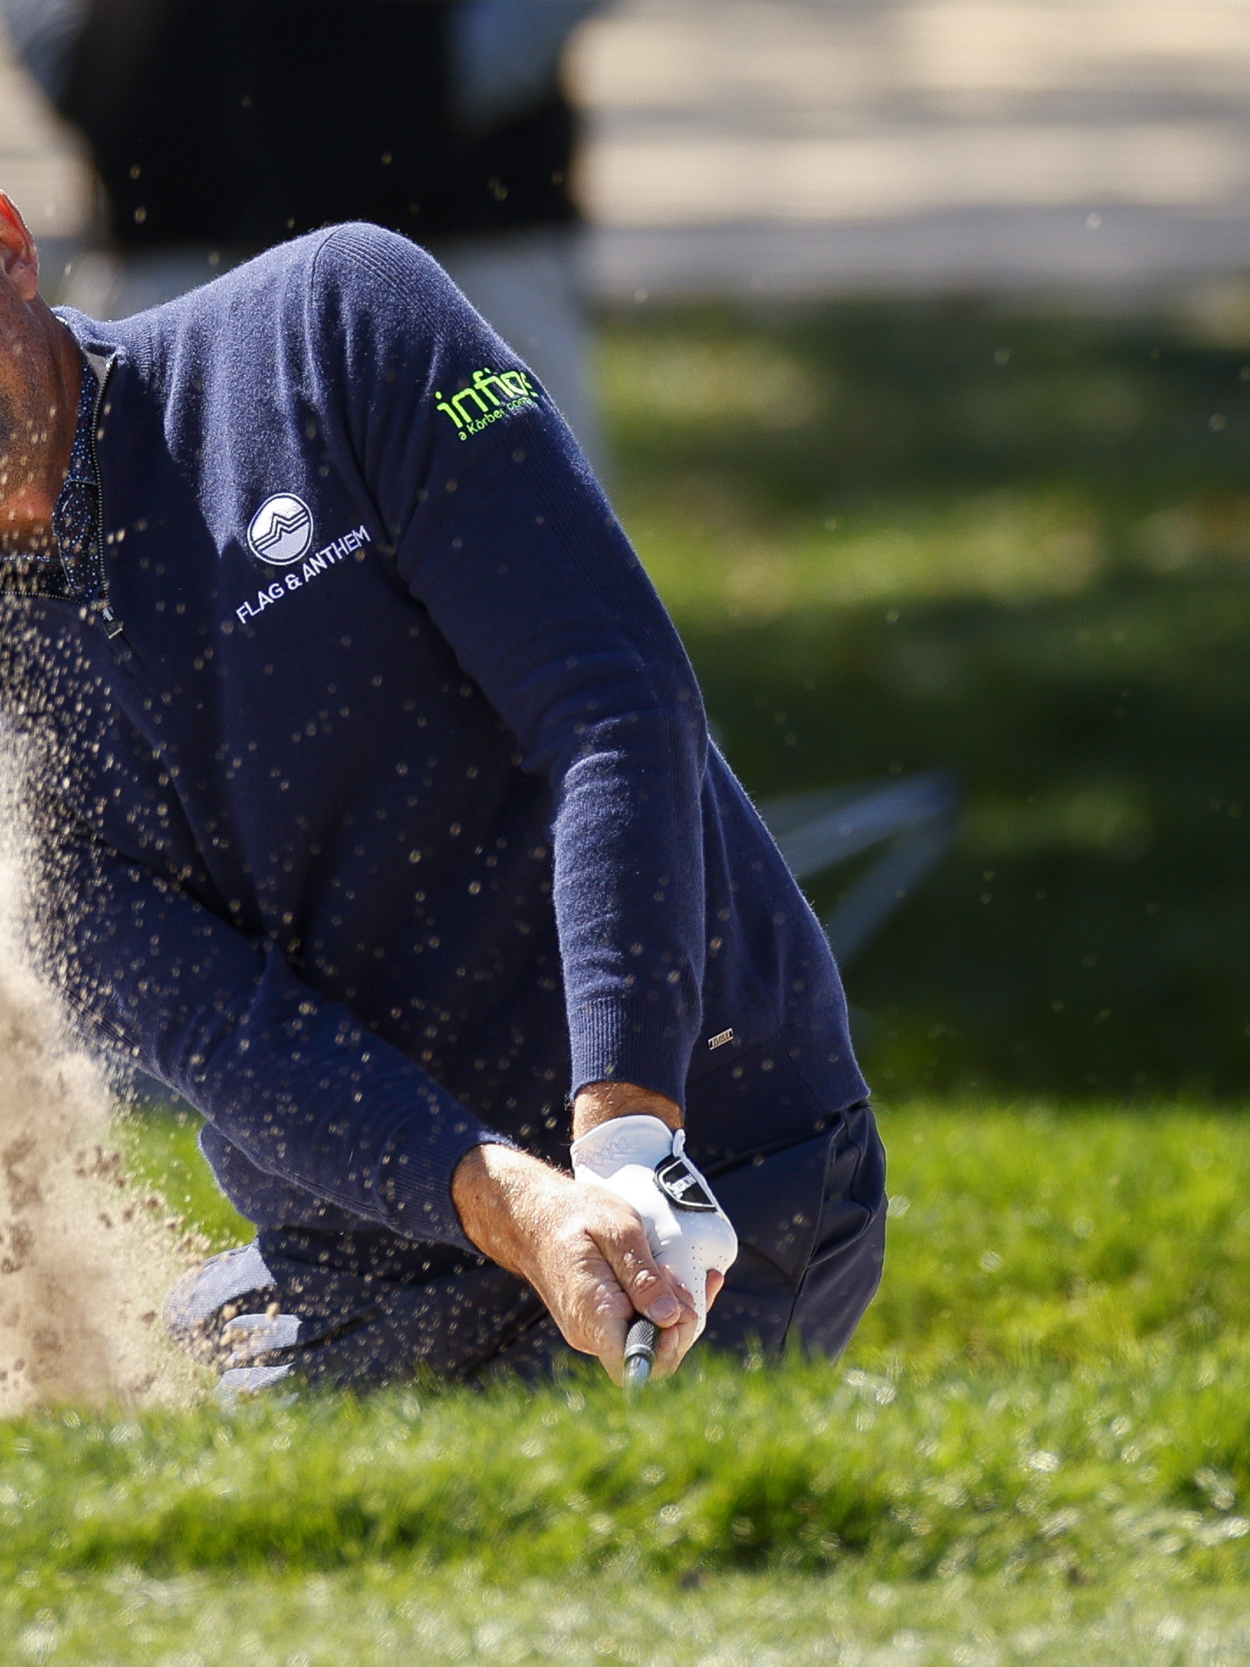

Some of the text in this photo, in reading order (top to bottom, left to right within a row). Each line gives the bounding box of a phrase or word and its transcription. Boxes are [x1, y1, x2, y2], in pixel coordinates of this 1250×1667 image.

[235, 524, 372, 624] FLAG & ANTHEM
